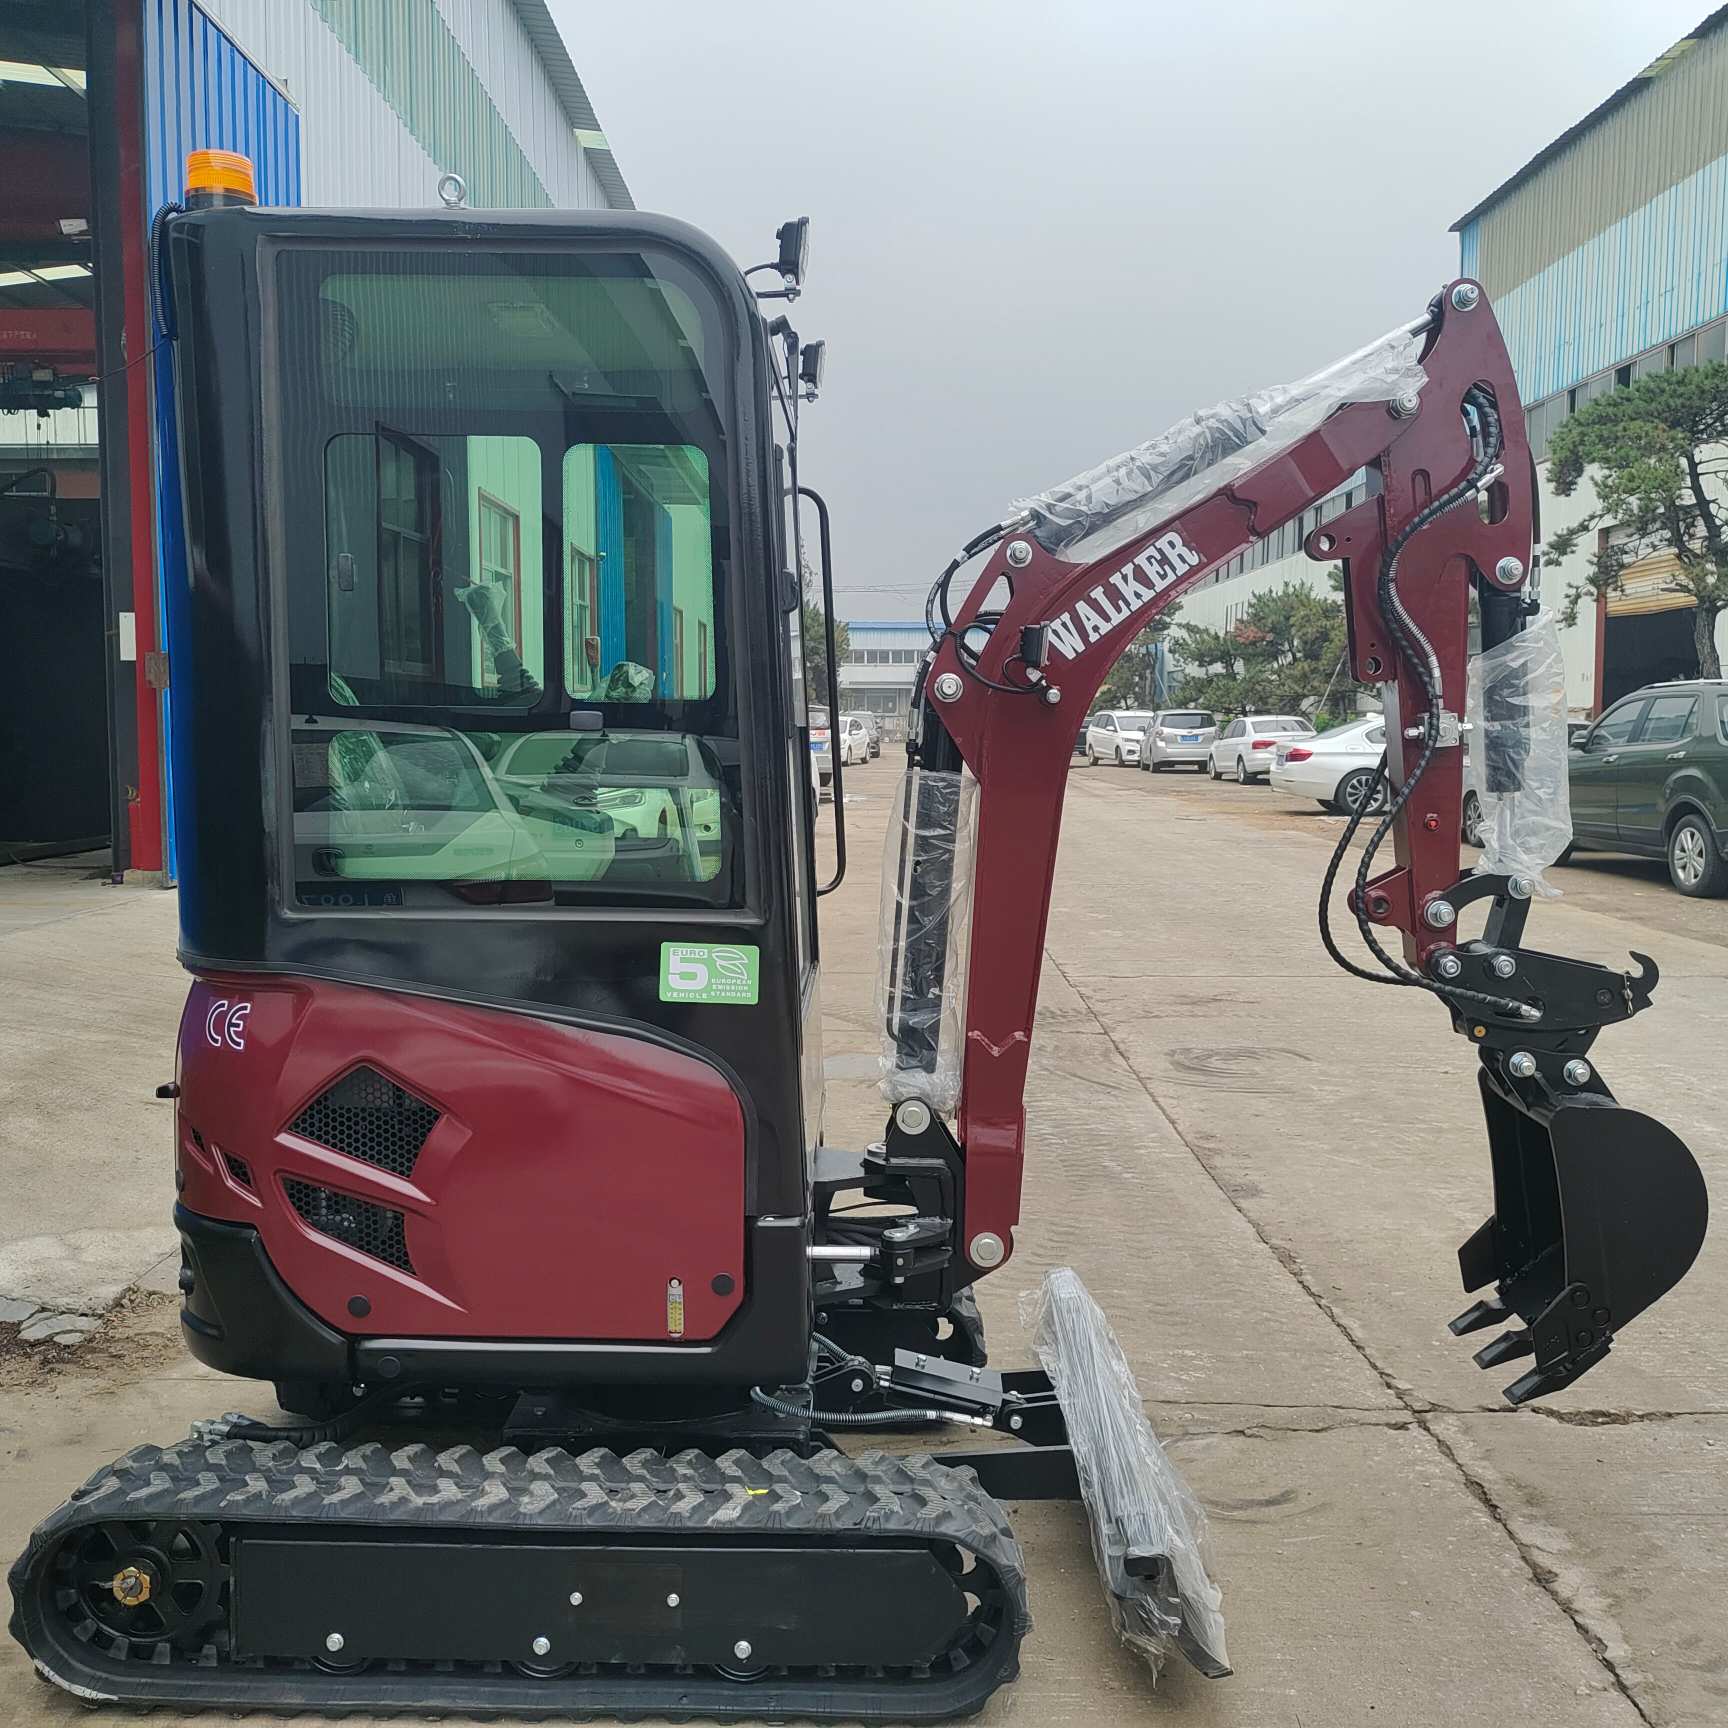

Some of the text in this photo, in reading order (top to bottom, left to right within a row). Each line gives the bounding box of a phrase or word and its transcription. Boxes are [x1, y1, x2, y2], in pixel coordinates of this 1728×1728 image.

[1050, 531, 1199, 660] WALKER
[668, 948, 709, 990] 5
[672, 949, 706, 957] EURO
[666, 991, 708, 999] VEHICLE
[206, 1000, 251, 1050] CE
